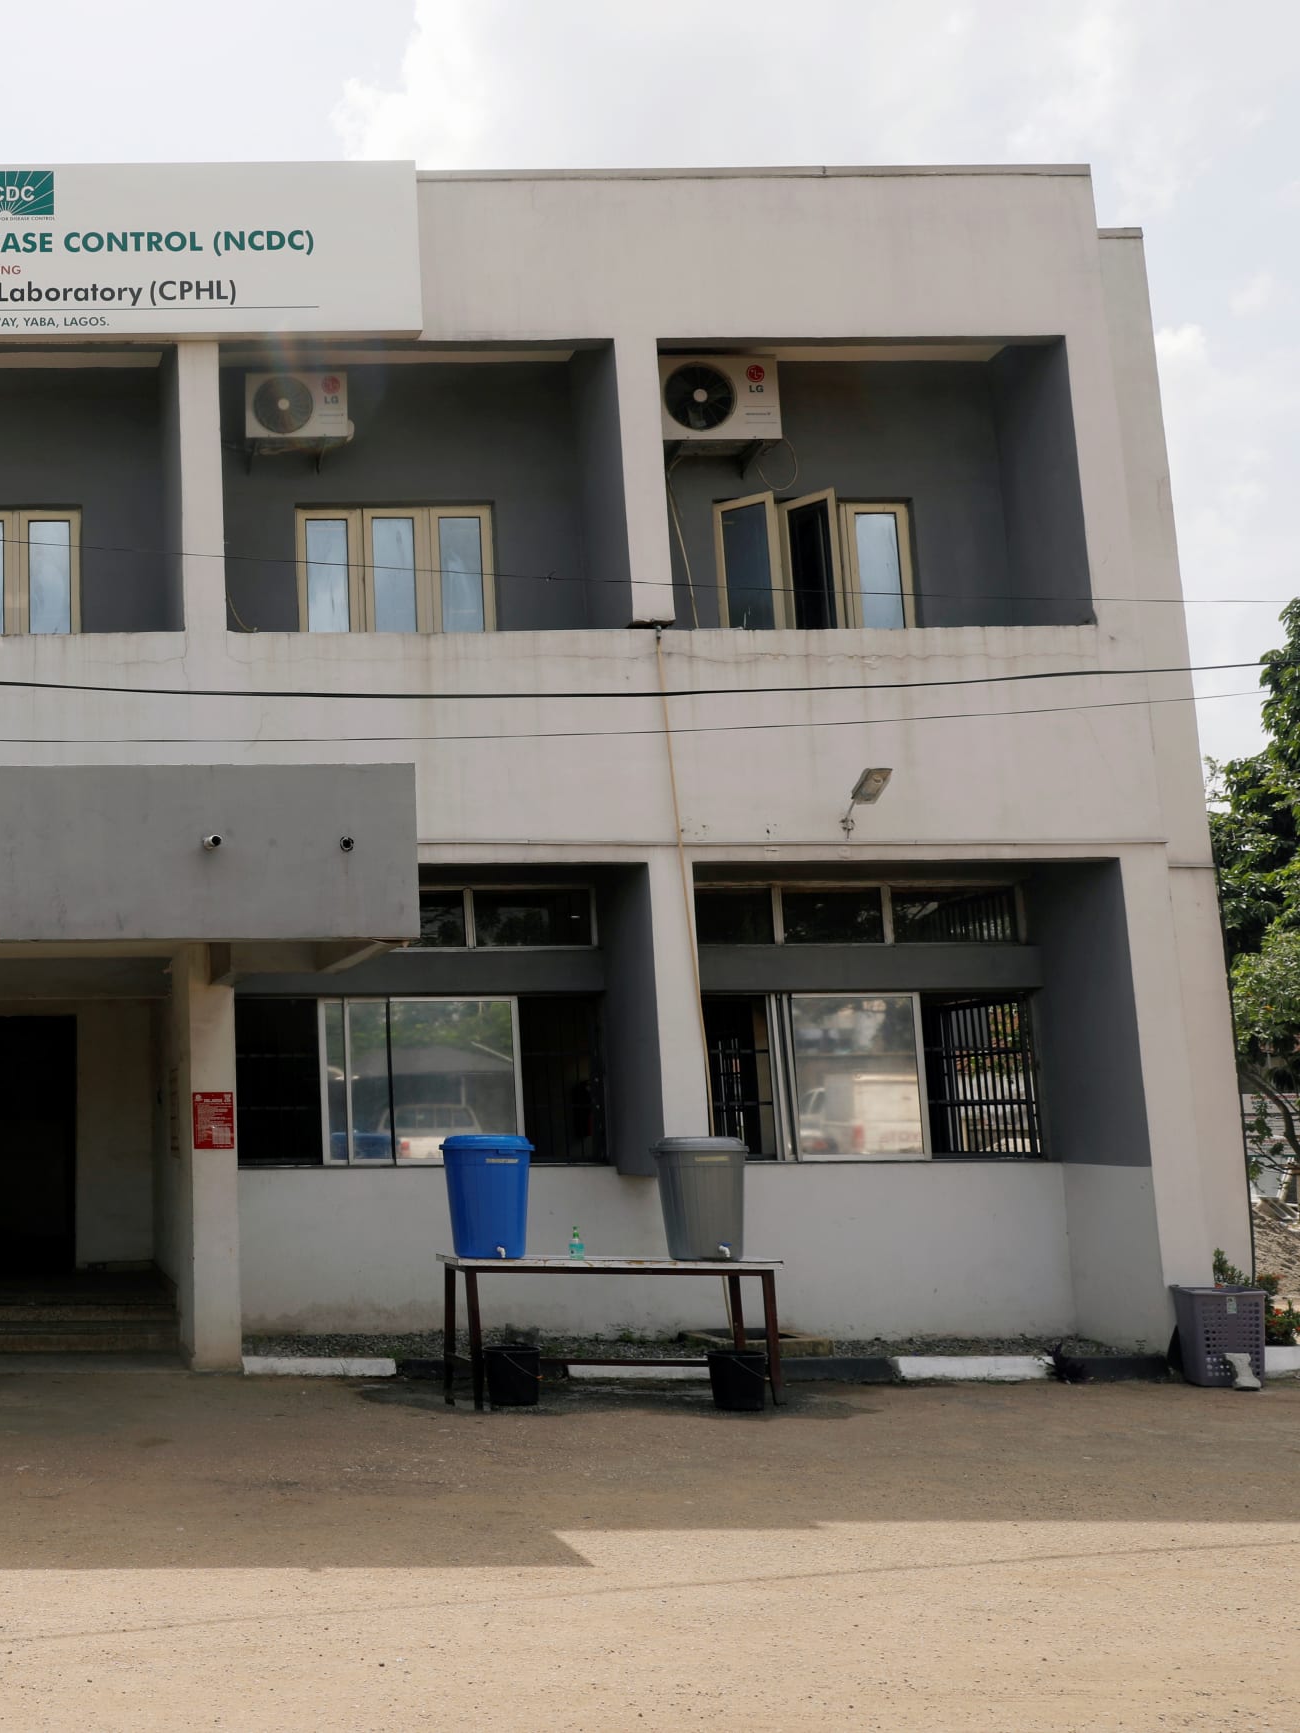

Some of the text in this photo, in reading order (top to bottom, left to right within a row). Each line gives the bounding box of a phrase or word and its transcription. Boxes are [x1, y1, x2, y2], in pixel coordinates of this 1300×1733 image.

[64, 232, 203, 252] CONTROL
[214, 230, 313, 256] (NCDC)
[150, 280, 236, 306] (CPHL)
[23, 317, 59, 328] YABA,
[64, 317, 109, 327] LAGOS.
[749, 384, 764, 393] LG
